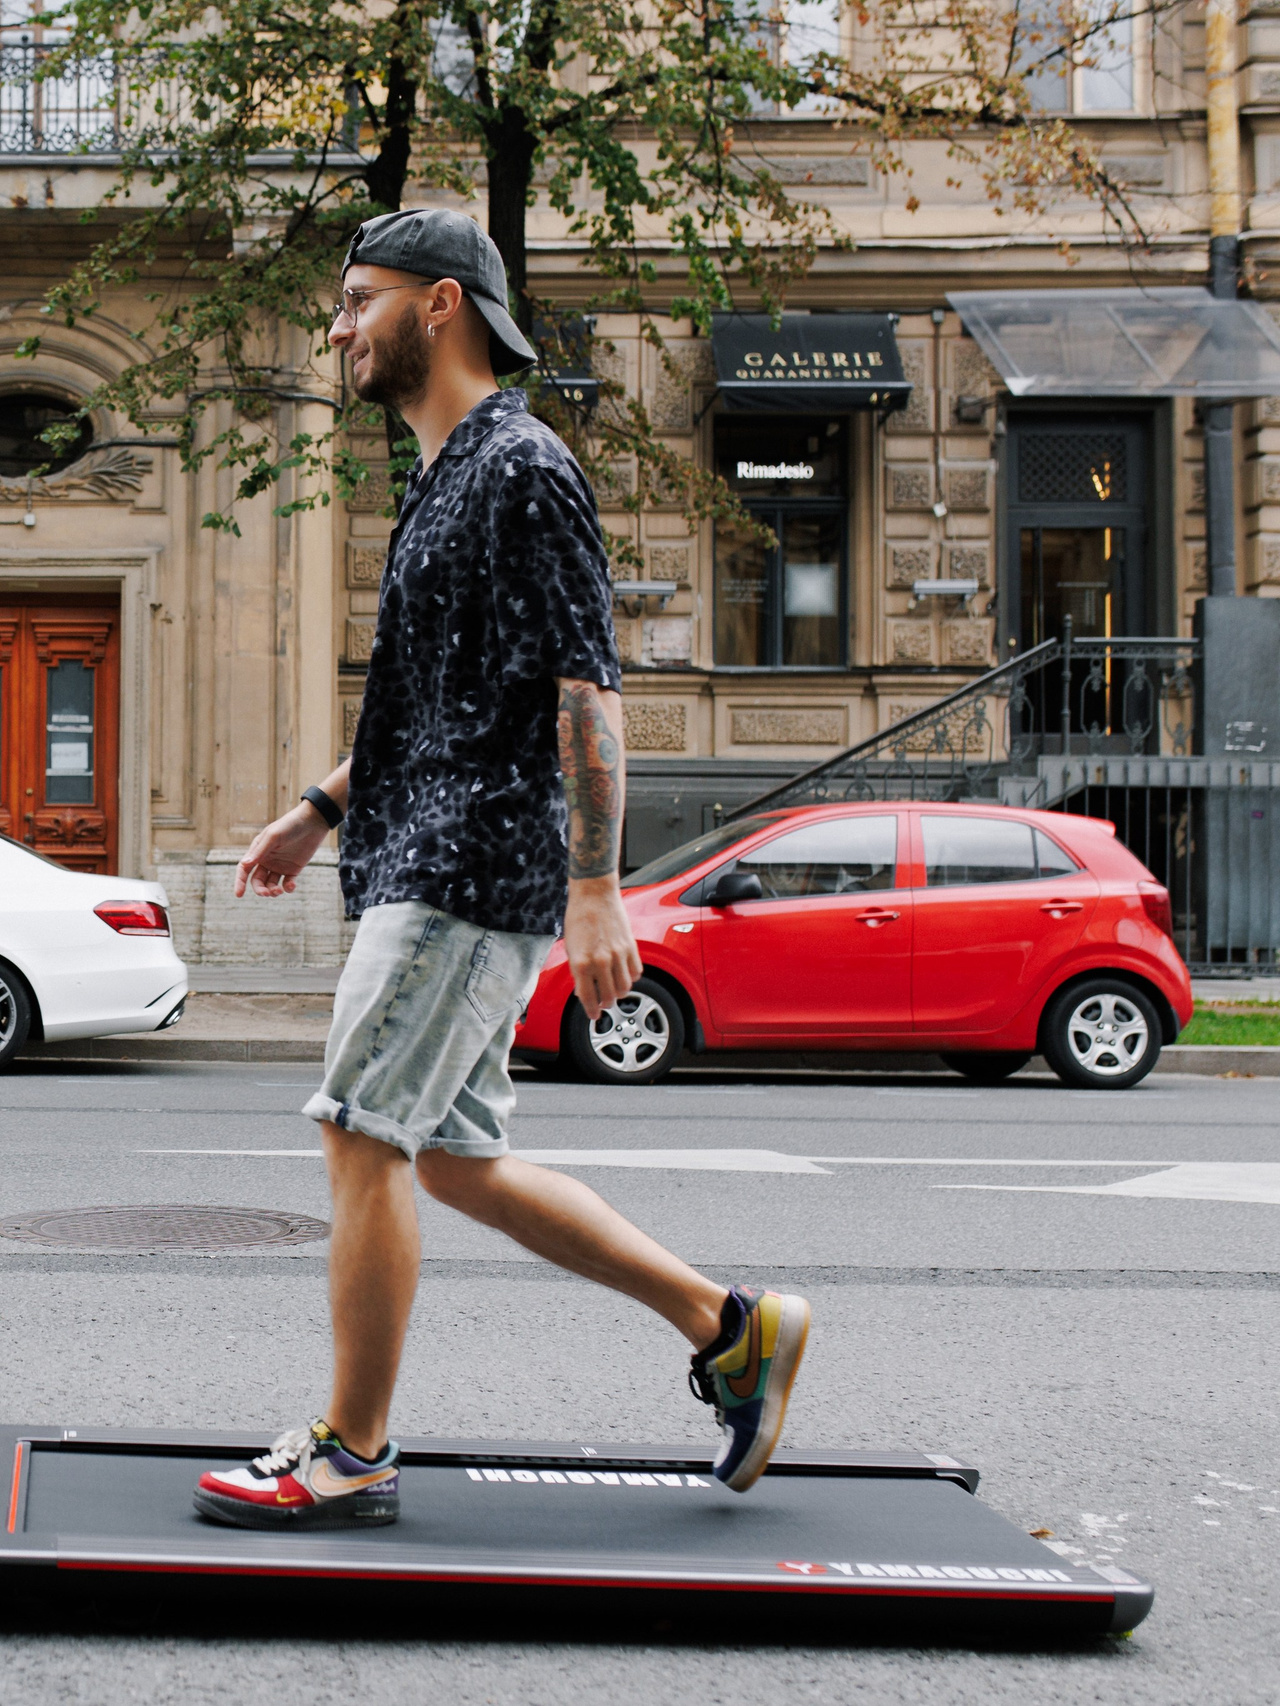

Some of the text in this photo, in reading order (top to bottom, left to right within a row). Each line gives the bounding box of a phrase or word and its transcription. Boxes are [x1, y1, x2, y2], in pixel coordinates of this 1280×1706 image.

[743, 351, 884, 367] GALERIE
[735, 368, 872, 380] QUARANTE-SIX
[737, 461, 814, 479] Rimadesio
[827, 1562, 1073, 1582] YAMAGUCHI
